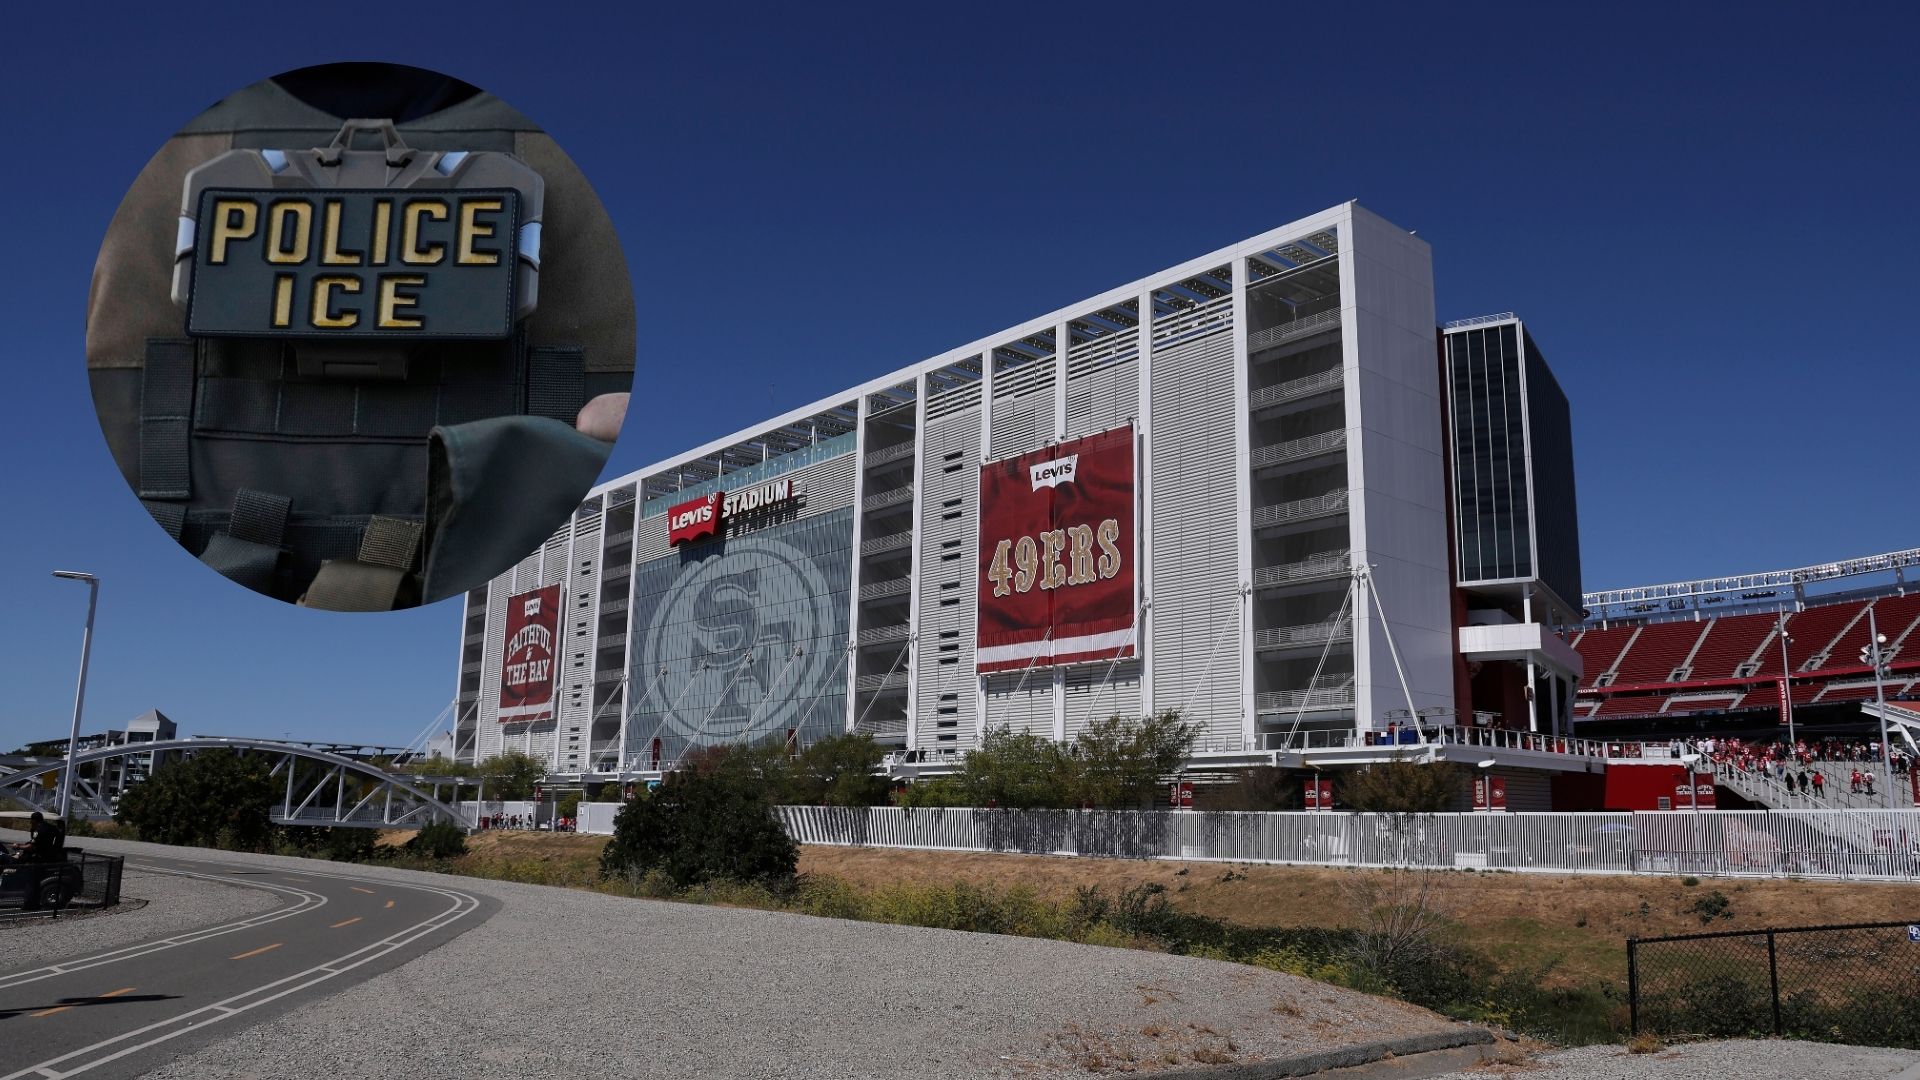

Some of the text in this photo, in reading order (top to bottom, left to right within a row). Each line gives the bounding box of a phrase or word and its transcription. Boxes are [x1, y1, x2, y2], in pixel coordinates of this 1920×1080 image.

[207, 197, 506, 267] POLICE
[271, 272, 429, 330] ICE
[722, 480, 789, 518] STADIUM
[988, 518, 1122, 598] 49ERS
[507, 623, 552, 663] FAITHFUL
[506, 659, 551, 686] THE BAY
